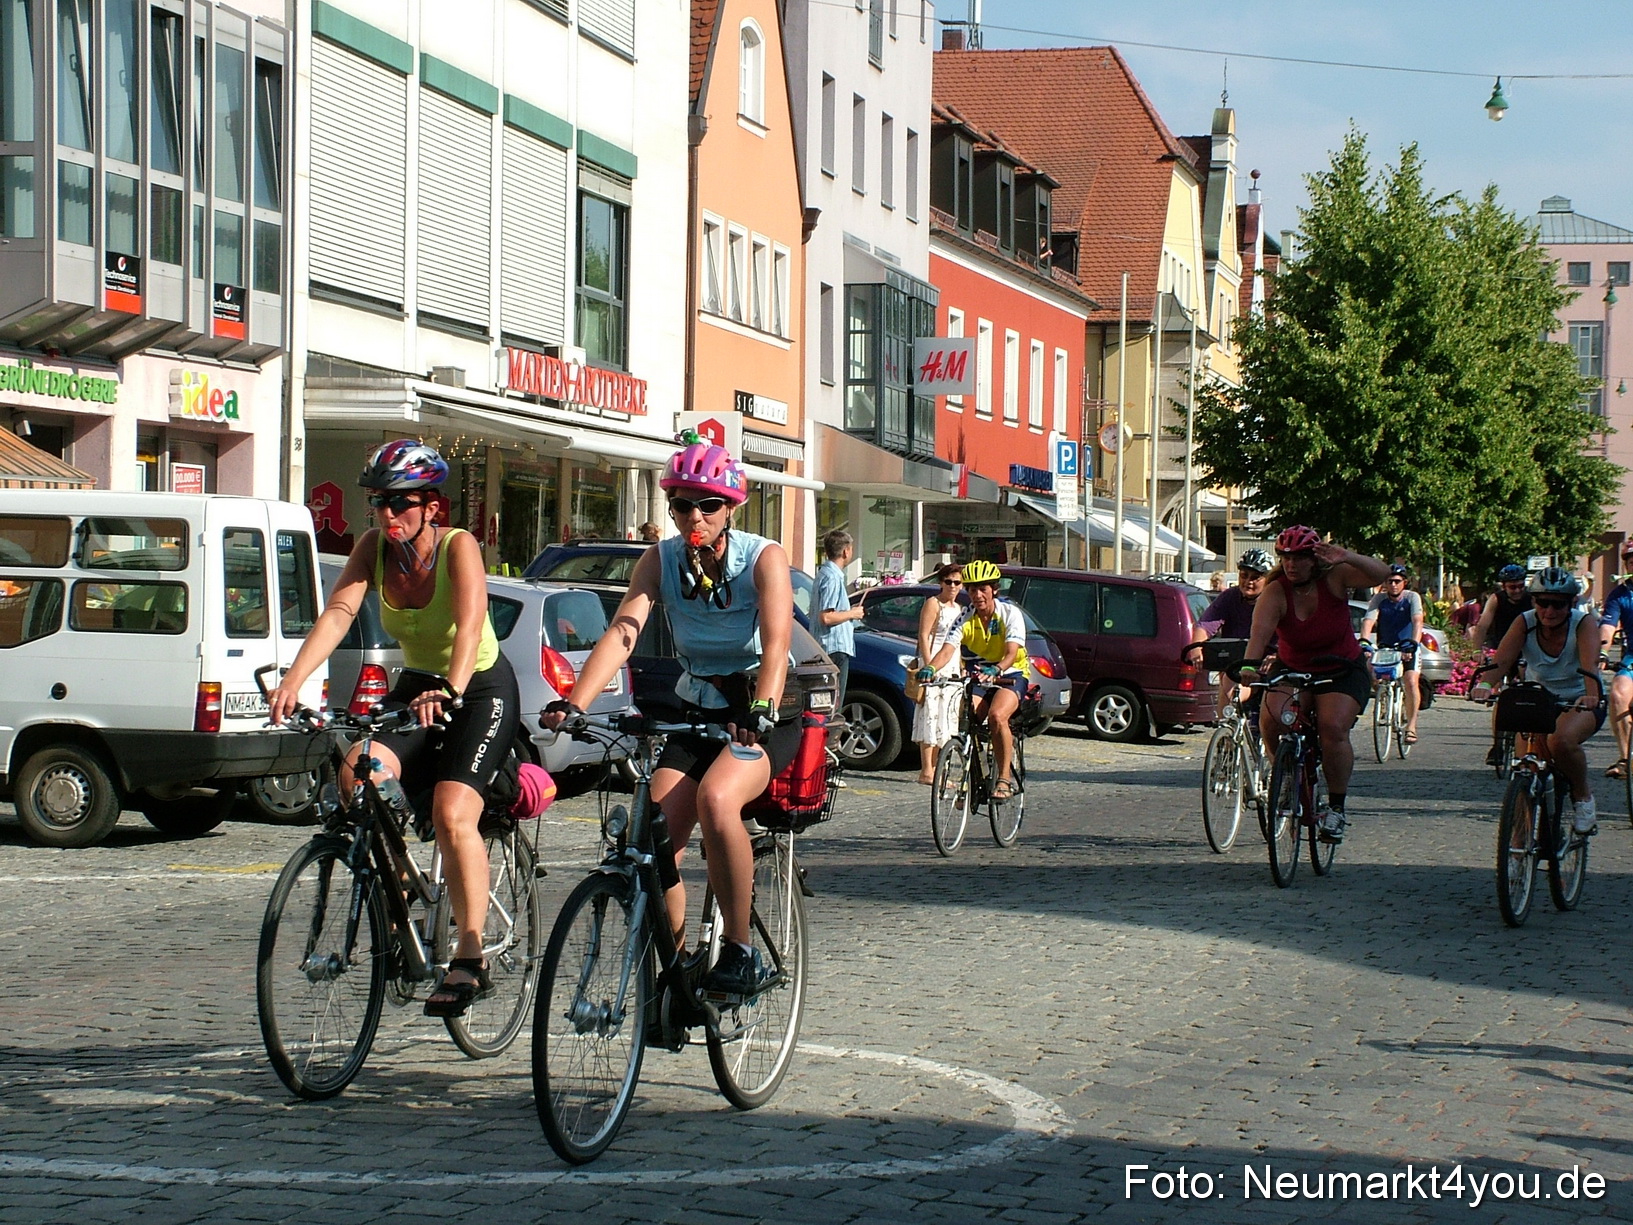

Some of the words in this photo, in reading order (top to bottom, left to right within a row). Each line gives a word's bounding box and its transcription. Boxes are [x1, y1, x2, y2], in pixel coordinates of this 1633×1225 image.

[507, 347, 647, 416] MARIEN-APOTHEKE
[920, 350, 968, 382] H&M
[183, 371, 240, 419] idea
[1061, 445, 1073, 471] P
[228, 696, 241, 711] NM
[245, 695, 257, 711] AK
